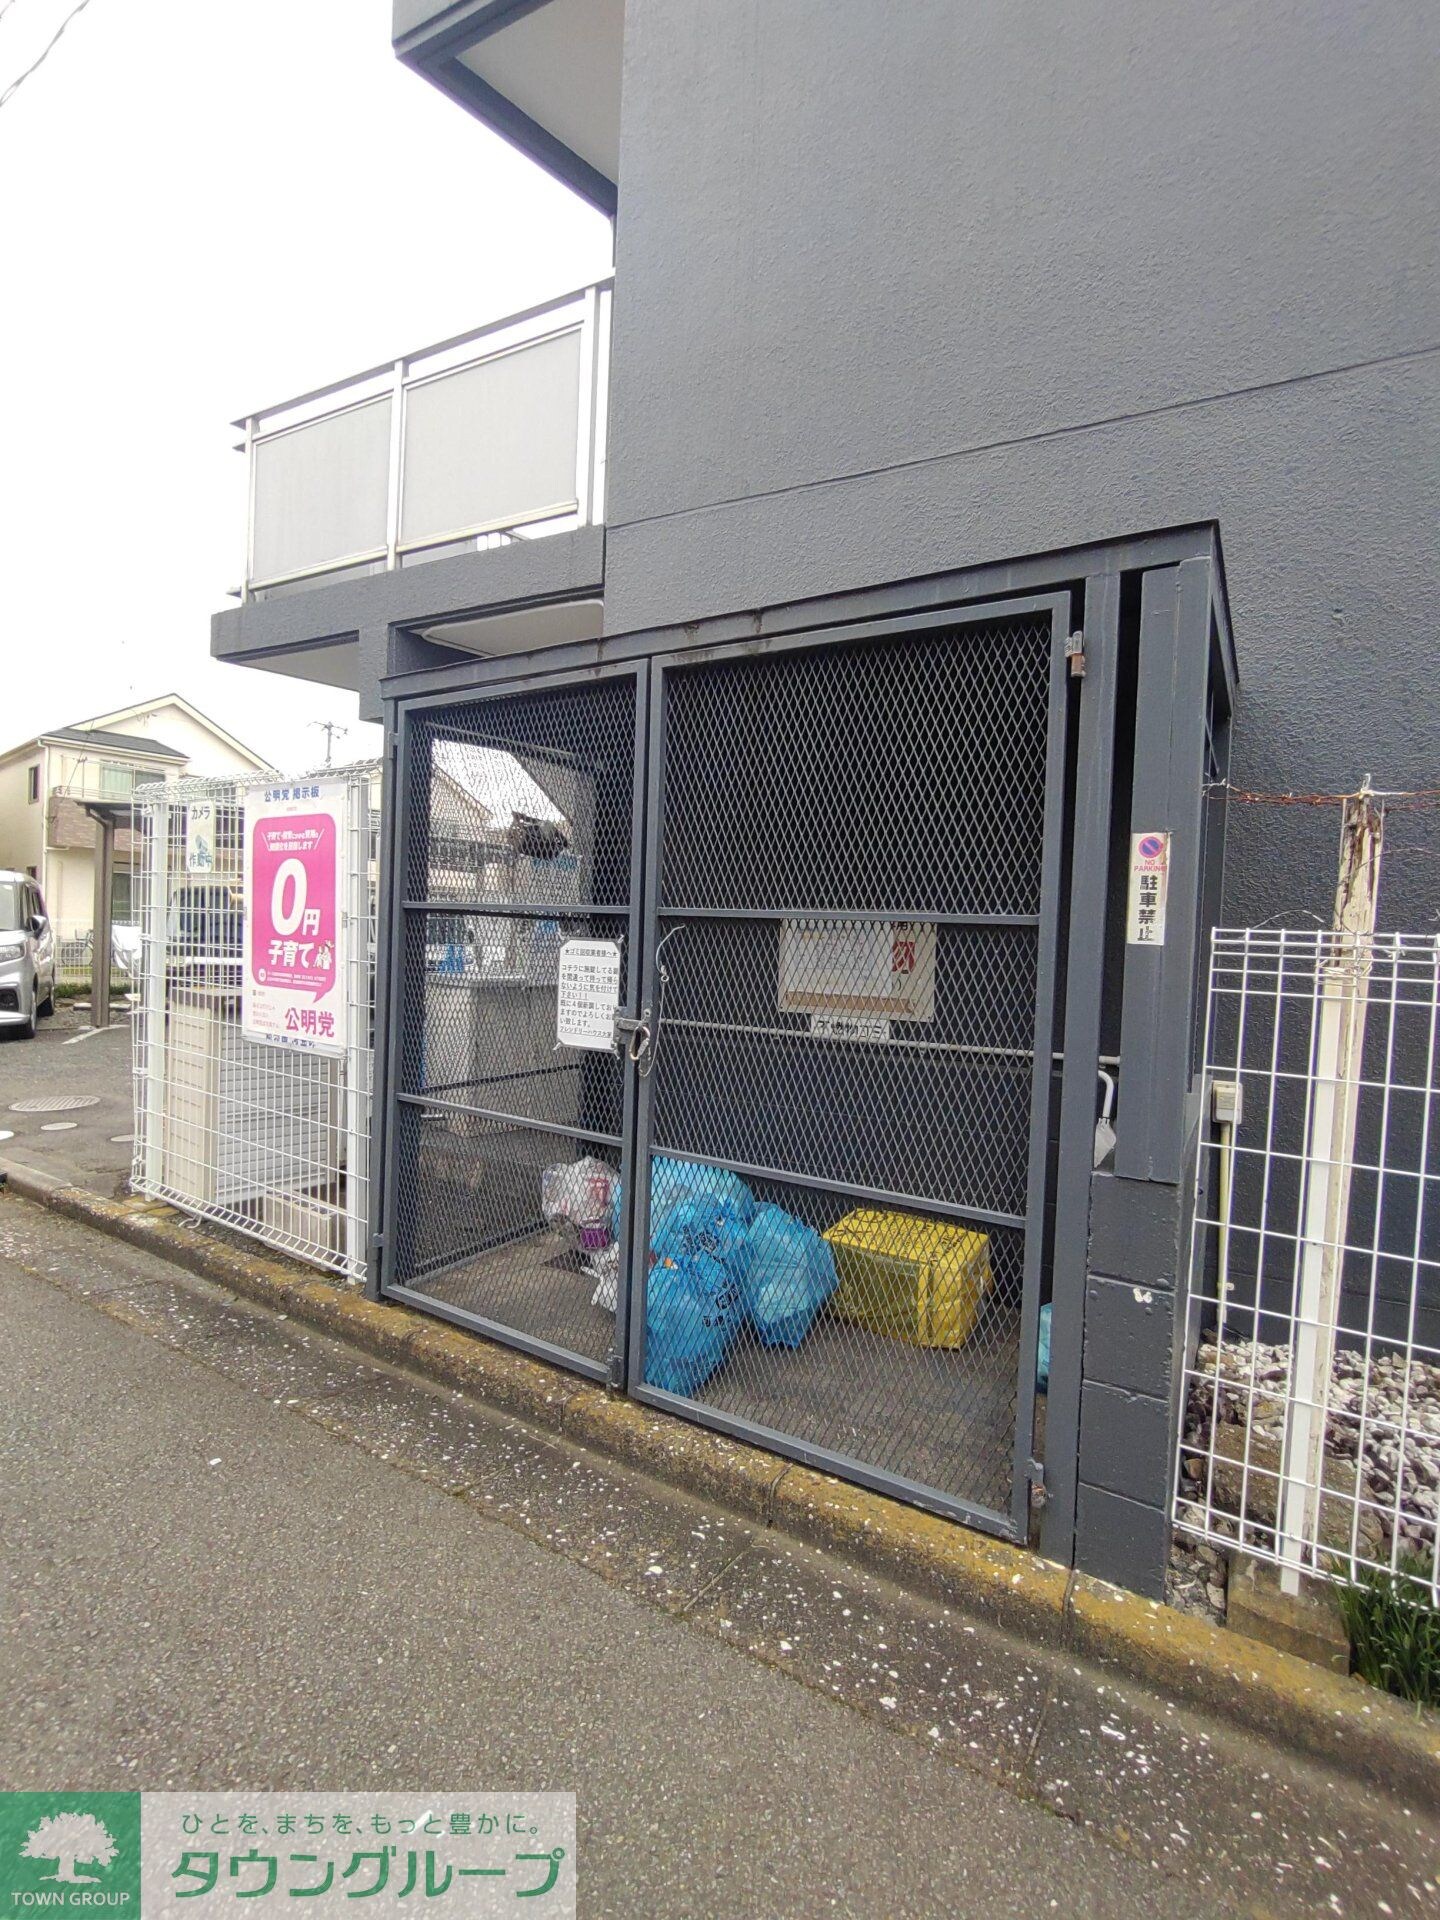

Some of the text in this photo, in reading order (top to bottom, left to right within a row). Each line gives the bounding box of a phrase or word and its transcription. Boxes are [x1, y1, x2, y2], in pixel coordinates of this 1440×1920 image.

[264, 786, 320, 802] 公明党 掲示板
[191, 806, 211, 820] カメラ
[189, 852, 213, 868] 作動中
[1137, 874, 1158, 942] 駐車禁止
[268, 940, 315, 969] 子育て
[285, 1007, 335, 1038] 公明党
